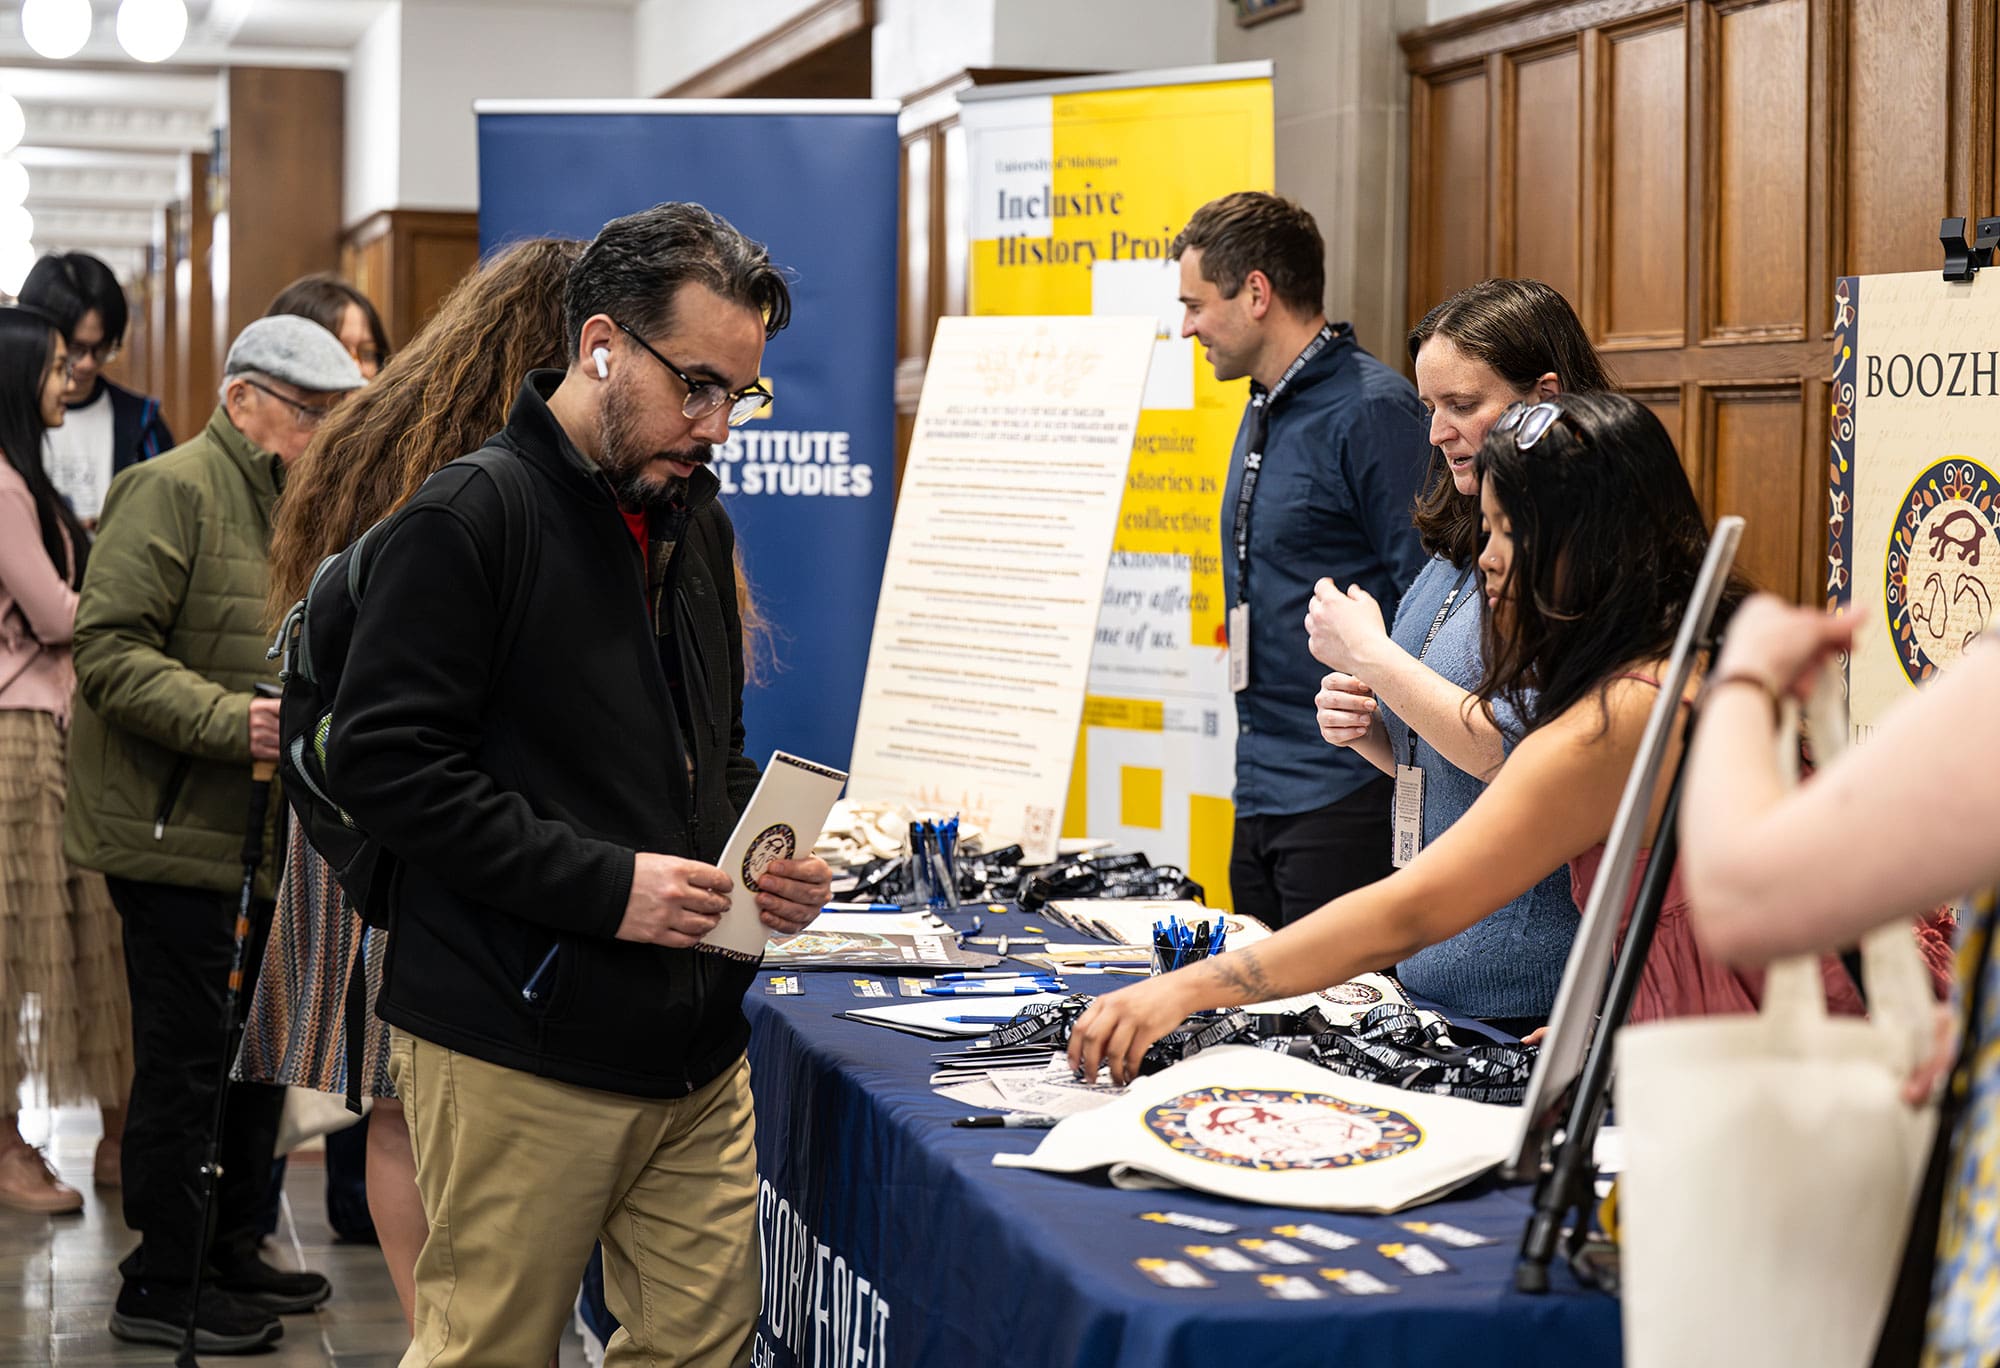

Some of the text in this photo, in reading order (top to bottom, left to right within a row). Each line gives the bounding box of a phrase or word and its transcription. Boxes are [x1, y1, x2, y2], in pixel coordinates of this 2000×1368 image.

[998, 182, 1124, 220] Inclusive
[998, 226, 1174, 270] History Proj
[1866, 351, 2000, 398] BOOZH
[1134, 428, 1197, 455] ognize
[706, 462, 873, 497] L STUDIES
[1124, 506, 1213, 534] collective
[1109, 544, 1218, 575] cknowledge
[1103, 586, 1144, 614] tory
[1125, 621, 1149, 652] of
[998, 1018, 1041, 1047] INCLUSIVE
[1197, 1018, 1235, 1050] HISTORY
[1442, 1067, 1461, 1083] M
[757, 1172, 808, 1364] STORY
